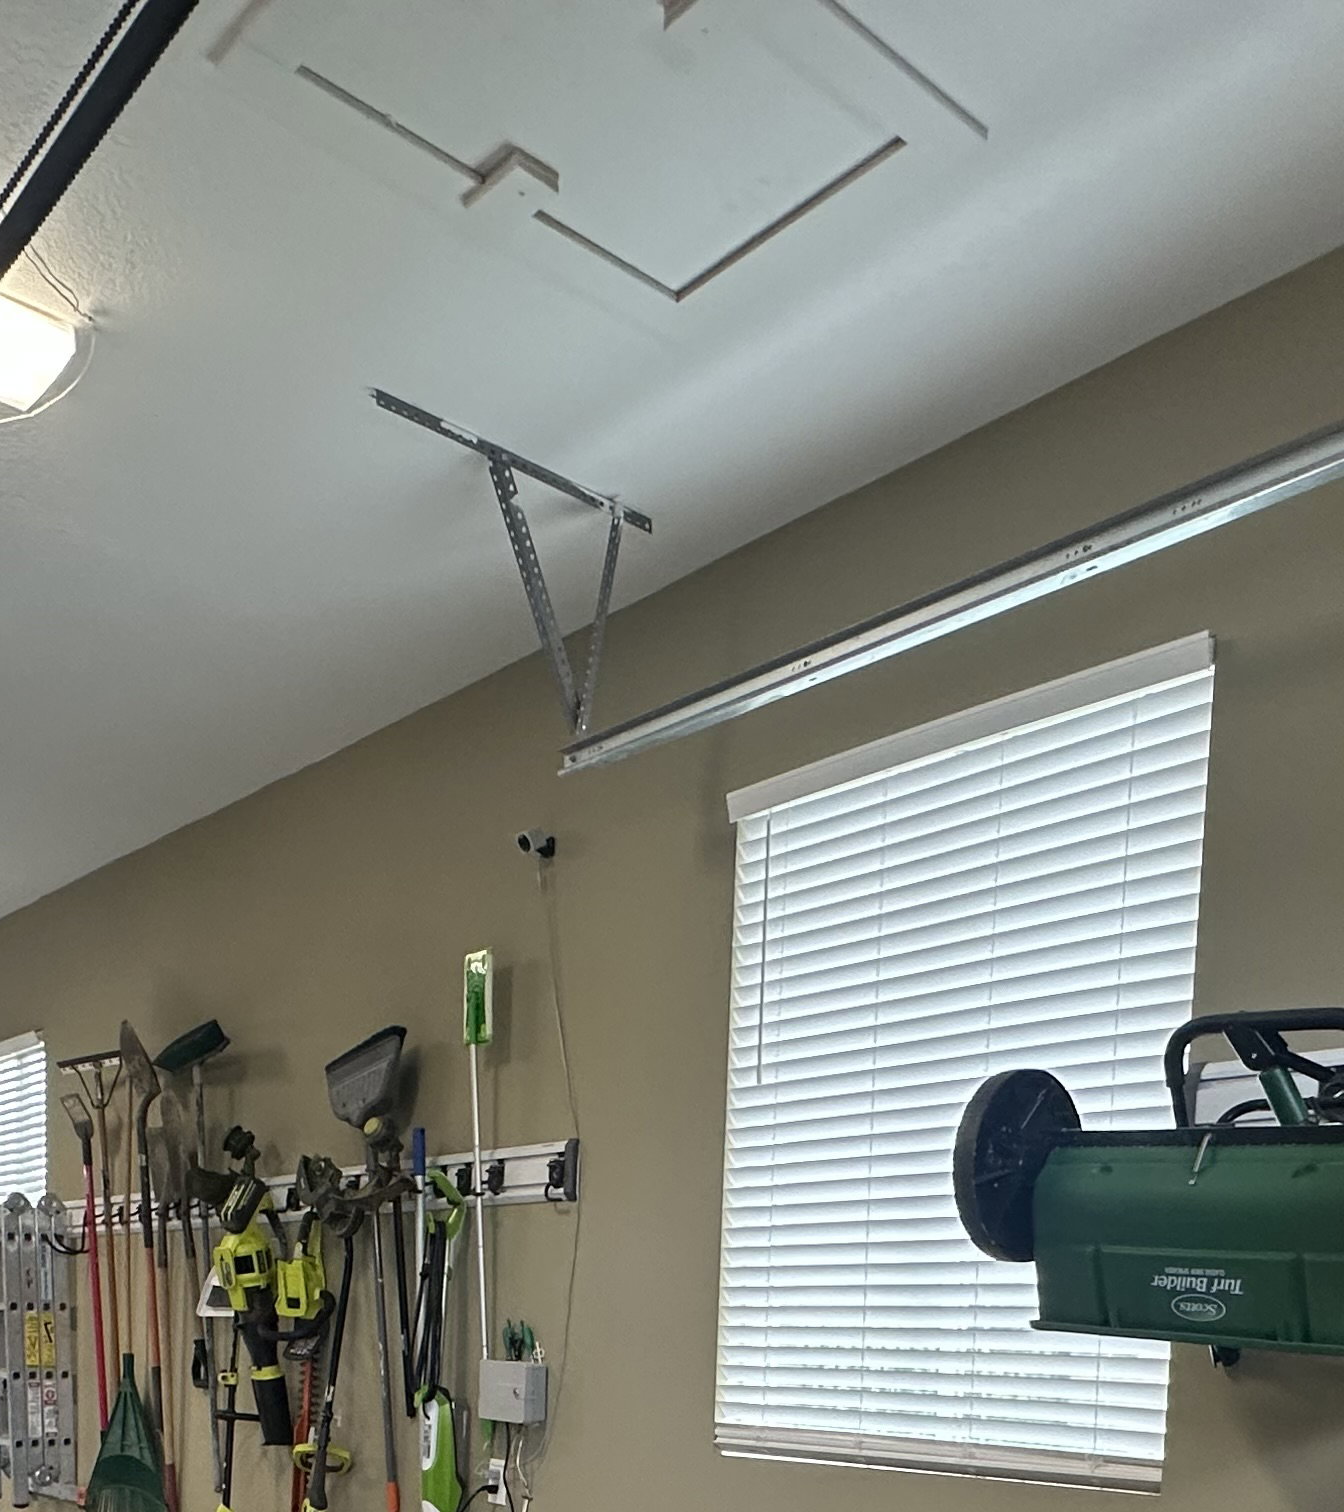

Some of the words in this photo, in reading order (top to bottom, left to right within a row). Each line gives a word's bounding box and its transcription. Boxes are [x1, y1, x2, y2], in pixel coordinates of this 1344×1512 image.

[1150, 1274, 1208, 1292] Builder
[1209, 1277, 1245, 1294] Turf
[1180, 1301, 1218, 1316] Scotts
